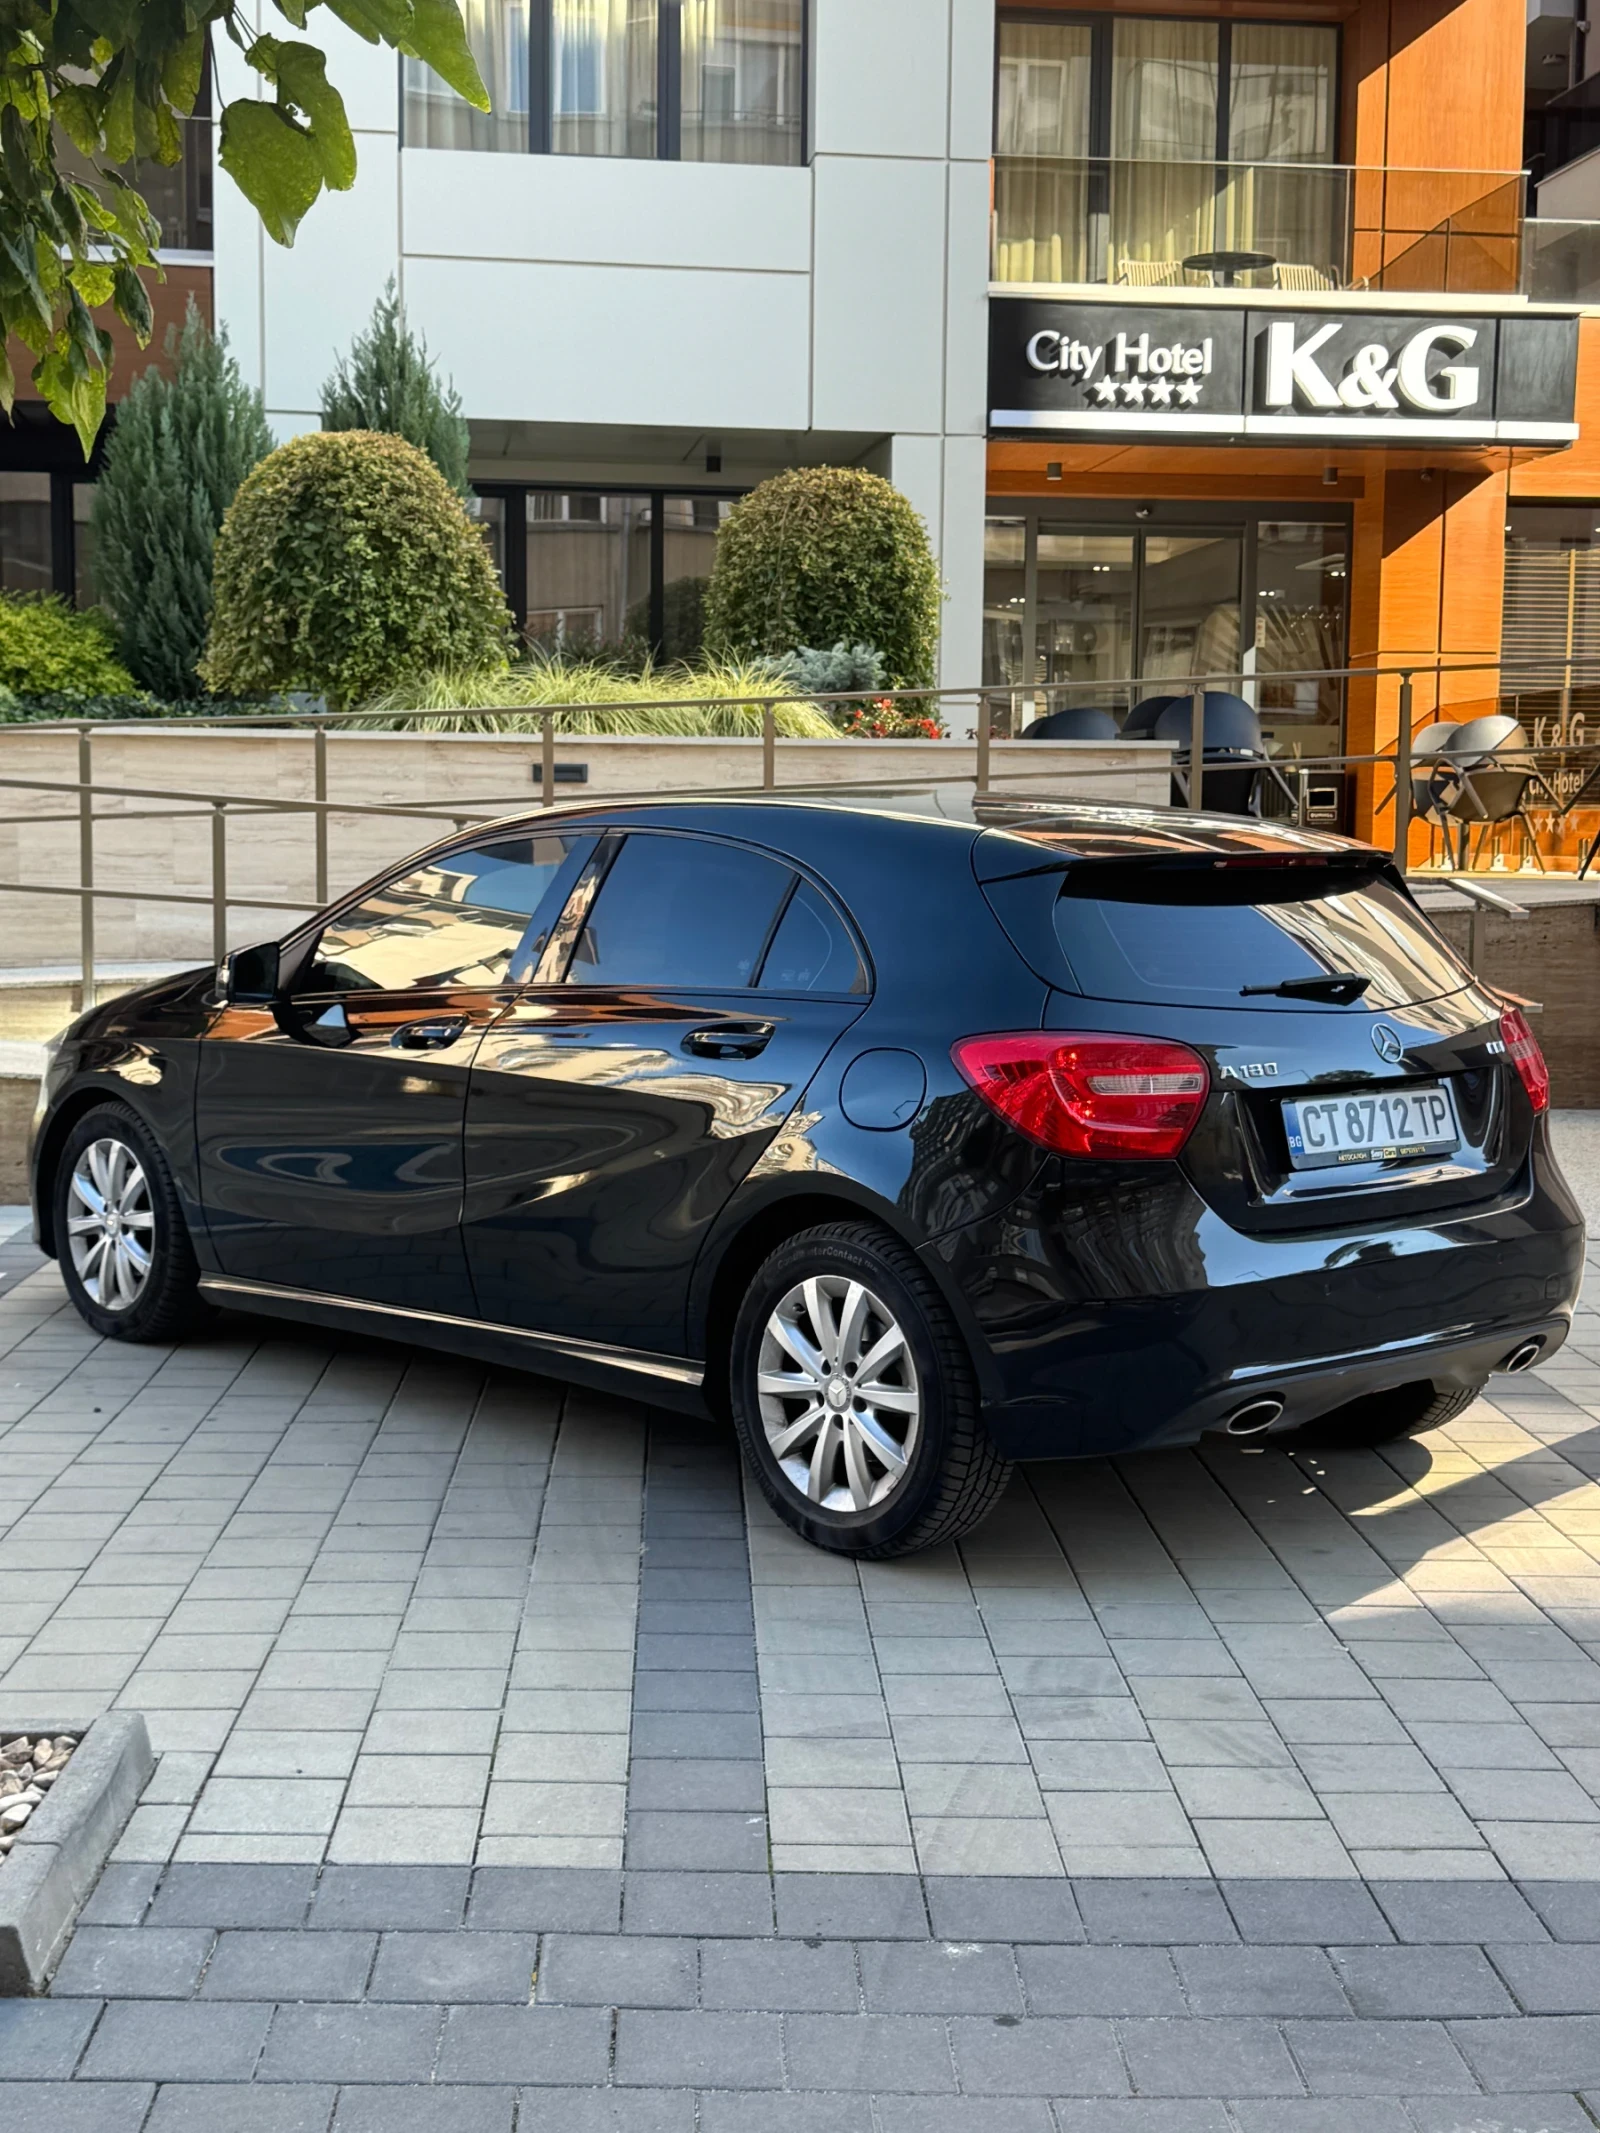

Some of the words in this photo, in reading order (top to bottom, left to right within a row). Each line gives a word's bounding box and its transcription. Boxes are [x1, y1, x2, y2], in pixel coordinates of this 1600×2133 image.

[1026, 330, 1102, 379] City
[1114, 332, 1213, 374] Hotel
[1265, 320, 1480, 411] K&G
[1529, 776, 1551, 800] Ciy
[1553, 768, 1584, 794] Hotel
[1289, 1136, 1302, 1148] BG
[1303, 1104, 1339, 1147] CT
[1345, 1097, 1414, 1143] 8712
[1412, 1095, 1446, 1136] TP
